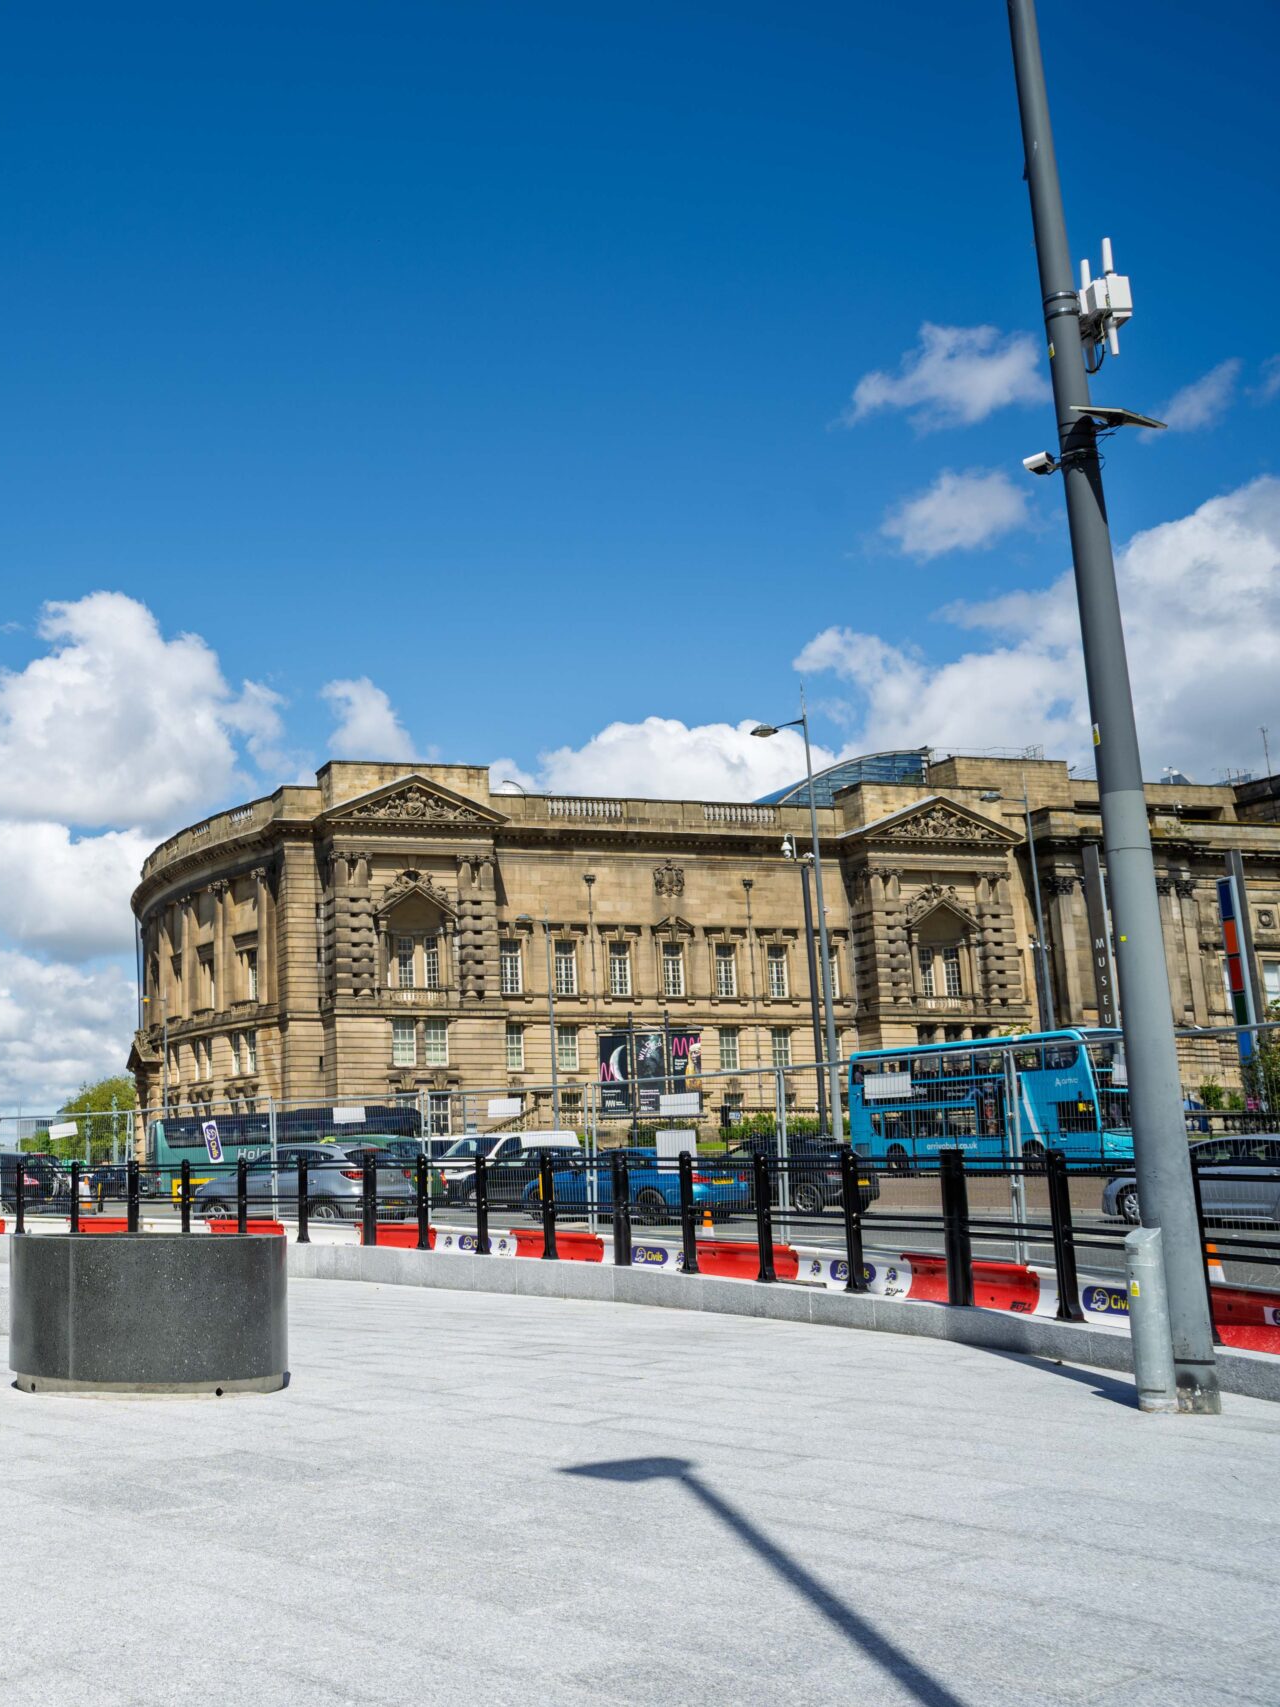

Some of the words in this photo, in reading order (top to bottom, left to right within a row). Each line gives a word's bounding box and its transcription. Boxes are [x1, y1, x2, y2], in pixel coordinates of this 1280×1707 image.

[1095, 938, 1112, 1025] MUSEU
[638, 1040, 651, 1060] WILD
[646, 1251, 664, 1262] Civils
[1111, 1295, 1129, 1310] Civi
